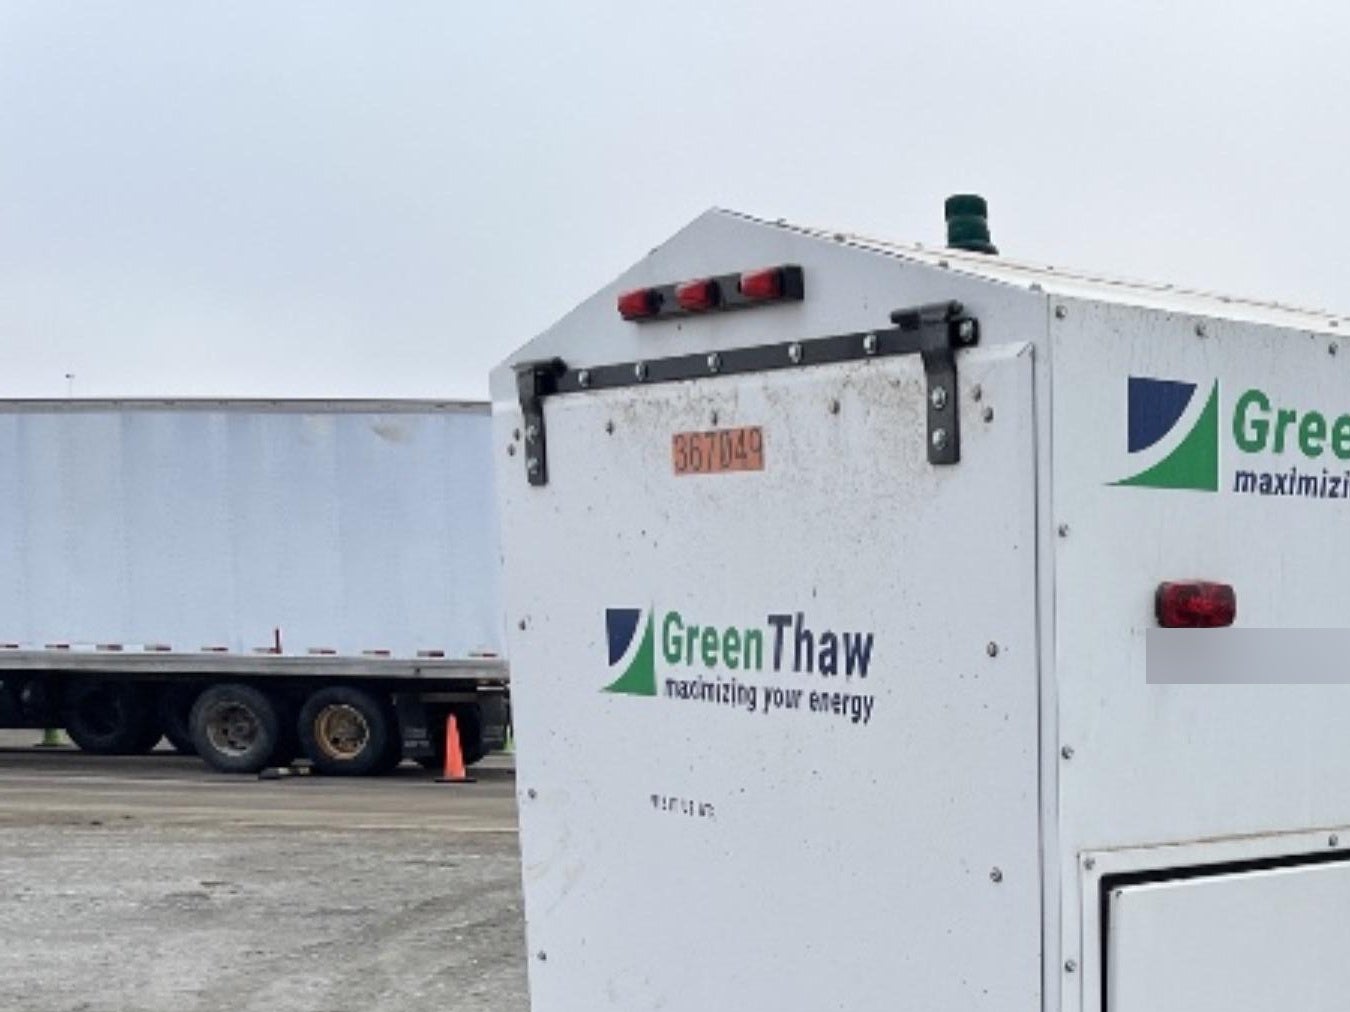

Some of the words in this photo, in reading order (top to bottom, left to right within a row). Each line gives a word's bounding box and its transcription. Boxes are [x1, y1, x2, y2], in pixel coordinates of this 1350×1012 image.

[673, 426, 765, 472] 367049
[662, 610, 874, 678] GreenThaw
[663, 674, 757, 713] maximizing
[762, 684, 803, 714] your
[808, 690, 875, 725] energy
